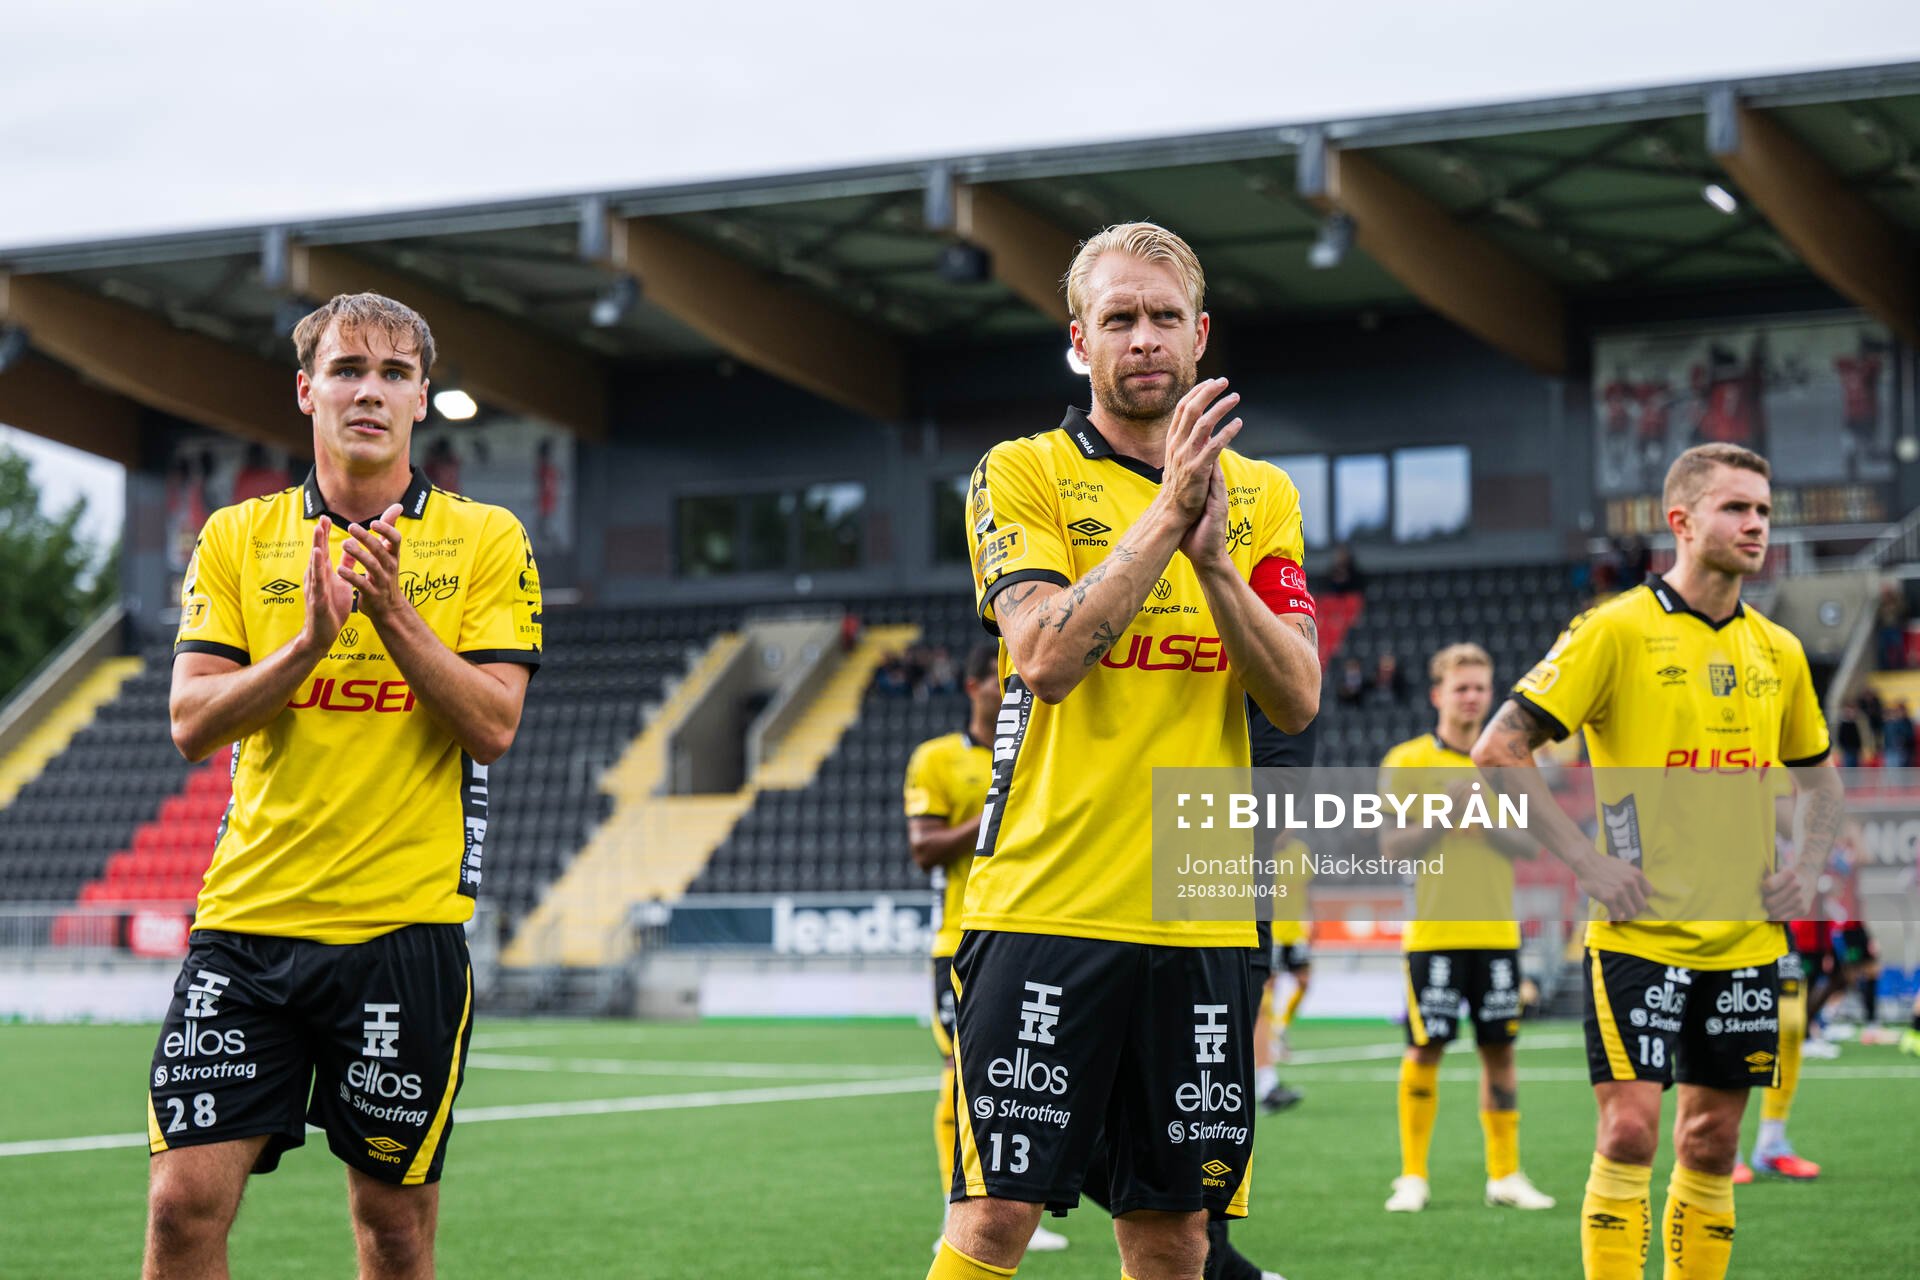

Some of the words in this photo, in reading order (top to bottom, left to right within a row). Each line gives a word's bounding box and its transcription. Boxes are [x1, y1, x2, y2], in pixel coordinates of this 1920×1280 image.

[1077, 432, 1095, 455] BORÅS
[1072, 538, 1108, 547] umbro
[263, 597, 295, 605] umbro
[399, 571, 461, 608] lfsborg
[1183, 606, 1200, 614] BIL
[1100, 634, 1231, 673] ULSE
[286, 678, 417, 713] ULSE
[1716, 981, 1773, 1014] ellos
[163, 1020, 246, 1057] ellos
[1638, 1034, 1665, 1068] 18
[171, 1061, 256, 1082] Skrotfrag
[348, 1060, 422, 1100] ellos
[988, 1047, 1069, 1095] ellos
[1175, 1070, 1242, 1112] ellos
[166, 1092, 217, 1134] 28
[353, 1095, 428, 1127] Skrotfrag
[998, 1099, 1071, 1129] Skrotfrag
[1189, 1120, 1248, 1145] Skotfrag
[368, 1150, 400, 1164] umbro
[990, 1132, 1031, 1174] 13
[1202, 1177, 1226, 1188] umbro
